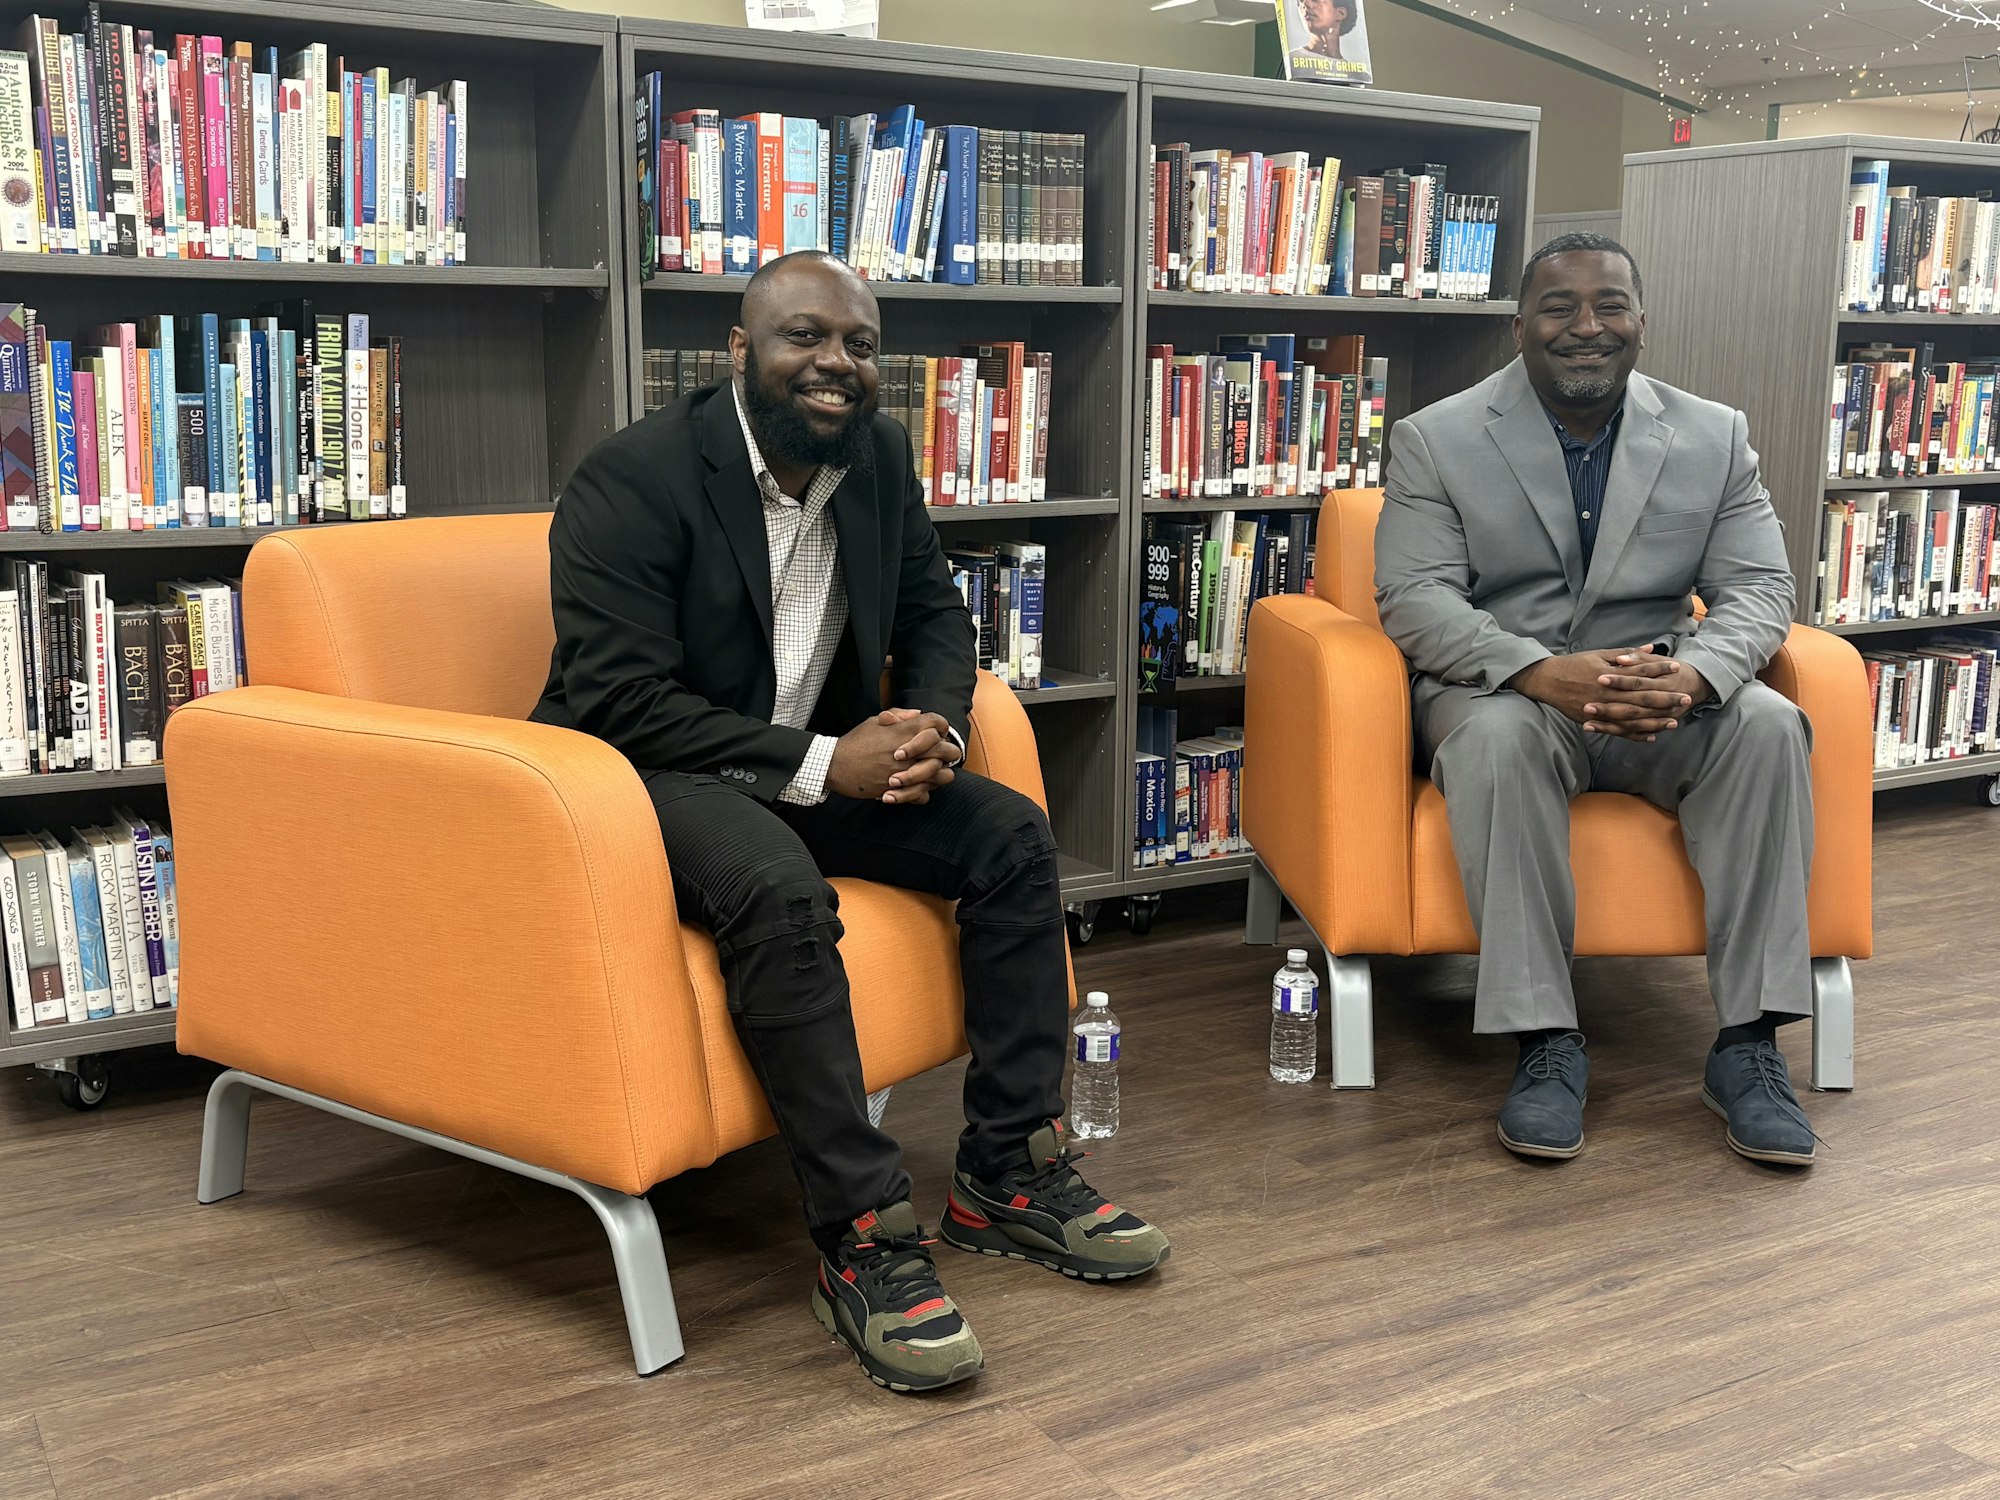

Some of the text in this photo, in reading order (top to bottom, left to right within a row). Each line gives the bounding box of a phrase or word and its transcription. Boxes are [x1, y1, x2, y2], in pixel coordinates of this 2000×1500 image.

[44, 32, 66, 132] ROUGH JUSTICE
[241, 62, 251, 109] Easy Beading
[1293, 57, 1368, 73] BRITTNEY GRINER
[0, 75, 14, 158] Collectibles
[9, 77, 24, 142] Antiques
[65, 57, 80, 158] DRAWING CARTOONS
[111, 31, 127, 162] modernism
[184, 88, 197, 157] CHRISTMAS
[289, 112, 297, 159] HANDMADE
[259, 129, 269, 186] Greeting Cards
[362, 92, 375, 202] custom knits accessories
[711, 144, 719, 176] Manual
[735, 130, 746, 176] Writer's
[834, 154, 848, 175] MLA
[56, 144, 71, 212] ALEX ROSS
[188, 158, 198, 191] Comfort
[289, 161, 298, 195] HOLIDAY
[762, 142, 774, 211] Literature
[819, 140, 829, 214] MLA Handbook
[834, 180, 848, 211] STYLE
[1219, 156, 1229, 206] BILL MAHER
[712, 190, 720, 221] Writers
[792, 203, 809, 218] 16
[1423, 176, 1436, 266] SHAKESPEARE'S LIVES
[1432, 183, 1444, 259] SCHOENBAUM
[208, 332, 216, 351] JANE
[316, 323, 343, 370] FRIDA
[0, 343, 15, 392] QUILTING
[127, 340, 136, 415] SUCCESSFUL QUILTING
[209, 354, 217, 389] SEYMOUR
[351, 384, 367, 392] Making
[962, 364, 974, 401] FLIGHT
[226, 404, 234, 427] Home
[299, 390, 307, 411] Strong
[375, 361, 384, 427] OUR WHITE BOY
[1026, 395, 1035, 420] Things
[1291, 365, 1302, 440] UMBERTO ECO
[111, 409, 125, 457] ALEK
[190, 409, 204, 435] 500
[211, 424, 219, 460] YOURSELF
[299, 412, 307, 426] Men
[350, 397, 368, 450] Home
[960, 415, 970, 452] FRIGHT
[995, 389, 1006, 464] Oxford Plays
[1211, 390, 1223, 450] LAURA BUSH
[1234, 420, 1249, 464] Bikers
[1892, 409, 1902, 438] LADIES
[182, 437, 191, 463] IDEAL
[226, 428, 236, 478] MAKEOVER
[300, 434, 308, 453] Tough
[300, 454, 309, 474] Times
[1143, 450, 1151, 478] AMBLER
[1147, 545, 1178, 563] 900-
[1147, 563, 1170, 581] 999
[1963, 517, 1974, 584] YOUNG STALIN
[1147, 584, 1162, 593] History
[1147, 591, 1170, 601] Geography
[120, 618, 149, 627] SPITTA
[161, 616, 188, 625] SPITTA
[193, 604, 205, 666] CAREER COACH
[208, 597, 224, 686] Music Business
[95, 612, 107, 740] ELVIS BY THE PRESLEYS
[124, 646, 145, 701] BACH
[164, 643, 186, 698] BACH
[69, 679, 90, 730] ADE
[1145, 779, 1156, 821] Mexico
[3, 876, 19, 934] GOD SONGS
[26, 871, 47, 948] STORMY WEATHER
[119, 860, 142, 942] THALIA
[134, 834, 162, 941] JUSTIN BIEBER
[99, 853, 128, 991] RICKY MARTIN ME
